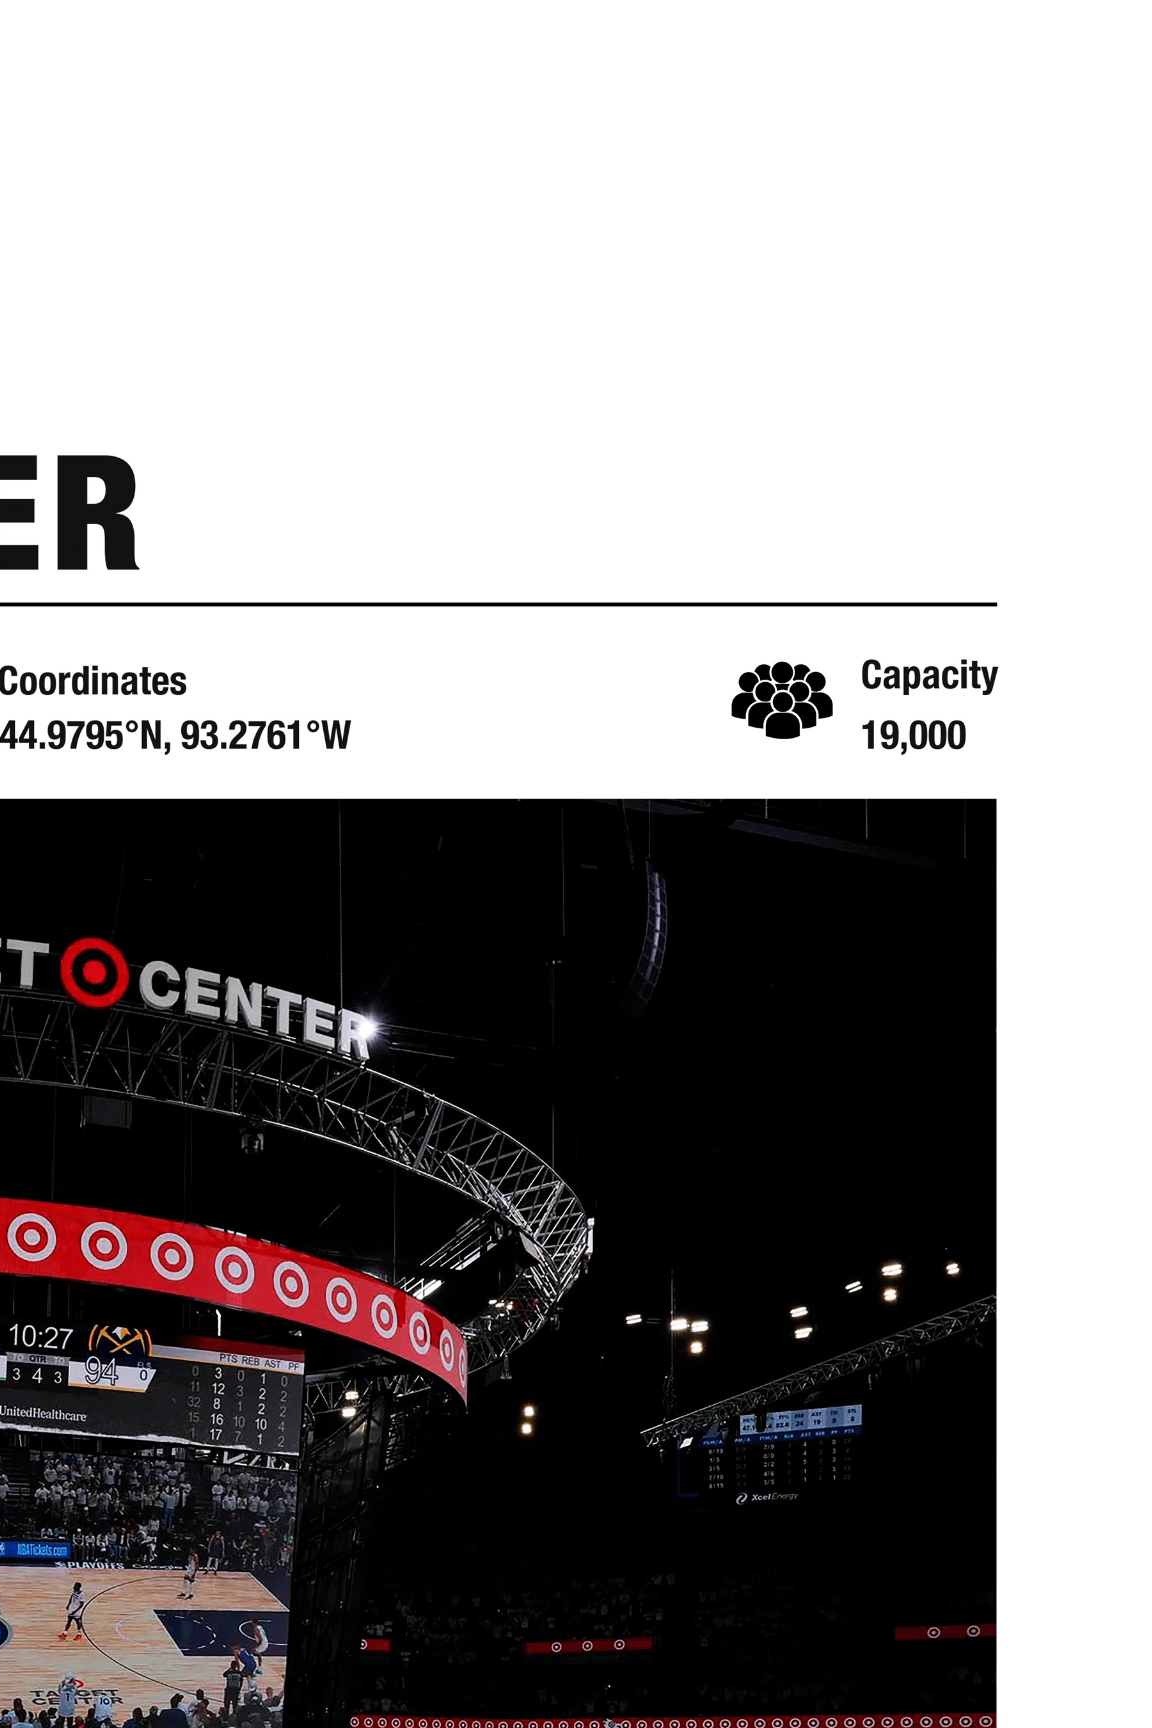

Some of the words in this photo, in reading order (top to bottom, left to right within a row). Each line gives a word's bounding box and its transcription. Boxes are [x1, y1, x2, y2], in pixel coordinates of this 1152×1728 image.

[139, 961, 370, 1060] CENTER
[9, 1324, 74, 1350] 10:27
[29, 1355, 46, 1364] QTR
[219, 1353, 238, 1364] PTS
[242, 1355, 260, 1366] REB
[264, 1358, 281, 1369] AST
[12, 1368, 21, 1381] 3
[31, 1368, 43, 1383] 4
[54, 1371, 62, 1383] 3
[84, 1356, 119, 1386] 94
[139, 1370, 148, 1381] 0
[214, 1367, 223, 1379] 3
[212, 1383, 226, 1395] 12
[259, 1388, 266, 1399] 2
[213, 1398, 221, 1410] 8
[258, 1403, 265, 1415] 2
[210, 1413, 224, 1426] 16
[254, 1419, 268, 1431] 10
[209, 1428, 223, 1441] 17
[17, 1543, 68, 1557] NBATickets.com
[68, 1561, 124, 1570] PLAYOFFS
